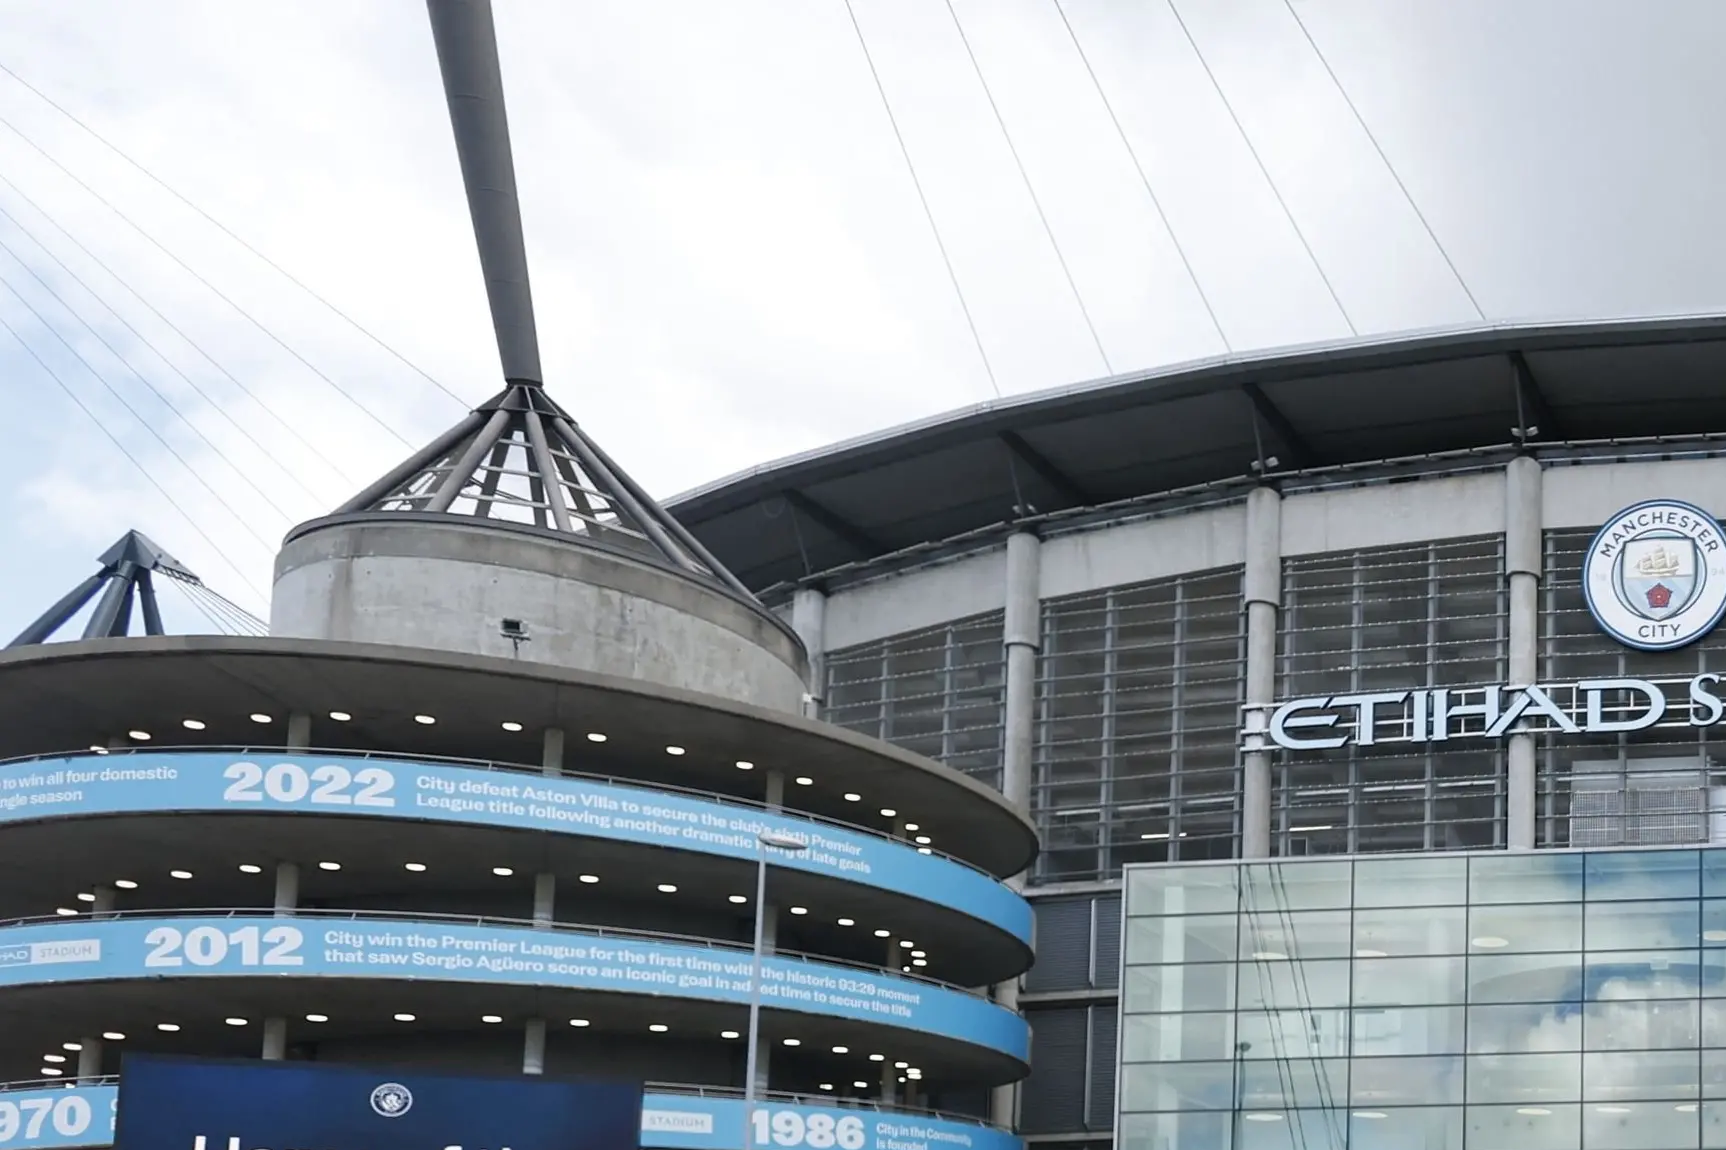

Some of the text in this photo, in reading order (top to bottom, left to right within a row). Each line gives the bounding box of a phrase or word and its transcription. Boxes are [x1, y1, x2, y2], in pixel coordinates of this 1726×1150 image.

[1600, 511, 1719, 557] MANCHESTER
[1638, 624, 1681, 638] CITY
[1270, 678, 1666, 749] ETIHAD
[3, 766, 178, 790] to win all four domestic
[30, 790, 82, 804] season
[223, 762, 396, 807] 2022
[416, 775, 455, 794] City
[459, 780, 518, 798] defeat
[523, 787, 576, 805] Aston
[580, 793, 618, 811] Villa
[621, 798, 639, 814] to
[642, 804, 698, 823] secure
[701, 811, 727, 829] the
[811, 834, 863, 856] Premier
[416, 793, 872, 874] League title following another dramatic of late goals
[40, 945, 92, 959] STADIUM
[144, 926, 304, 967] 2012
[324, 930, 920, 1005] City win the Premier League for the first time the historic moment
[324, 949, 912, 1018] that saw Sergio Agüero score an iconic goal in time to secure the title
[649, 1115, 706, 1129] STADIUM
[752, 1109, 865, 1150] 1986
[876, 1122, 898, 1138] City
[900, 1125, 909, 1137] in
[910, 1127, 925, 1139] the
